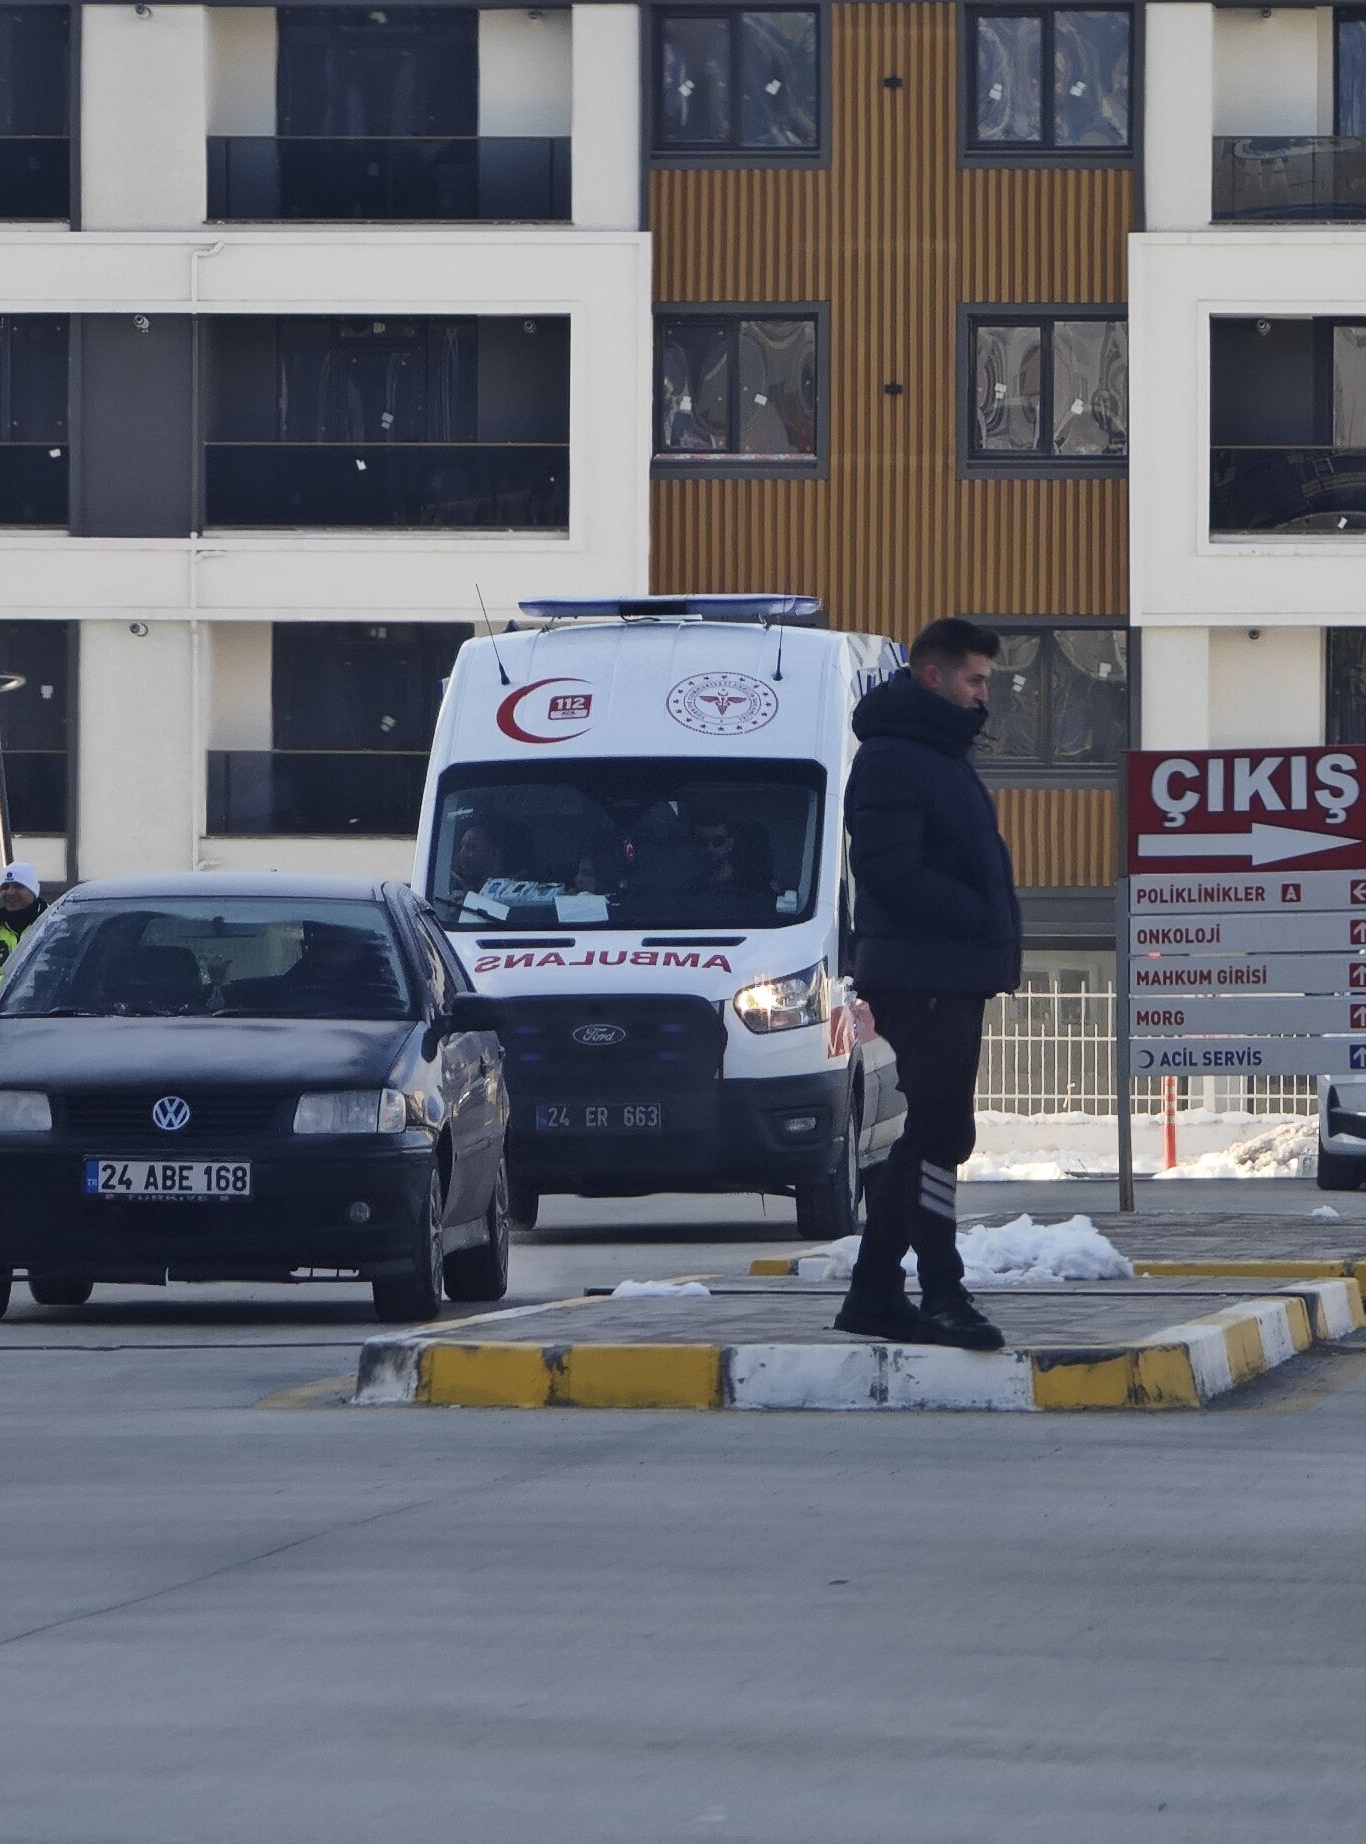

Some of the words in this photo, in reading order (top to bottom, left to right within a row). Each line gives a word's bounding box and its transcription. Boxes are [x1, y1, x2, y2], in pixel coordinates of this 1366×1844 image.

[556, 697, 586, 710] 112
[1150, 753, 1361, 828] ÇIKIŞ
[1136, 883, 1266, 904] POLİKLİNİKLER
[1285, 887, 1297, 901] A
[1136, 923, 1221, 945] ONKOLOJİ
[1136, 969, 1212, 986] MAHKUM
[1136, 1010, 1184, 1026] MORG
[582, 1027, 617, 1042] Ford
[1160, 1048, 1198, 1067] ACİL
[1202, 1046, 1263, 1067] SERVİS
[548, 1107, 570, 1127] 24
[585, 1106, 609, 1127] ER
[623, 1106, 658, 1127] 663
[101, 1164, 133, 1190] 24
[143, 1164, 194, 1191] ABE
[203, 1165, 248, 1192] 168
